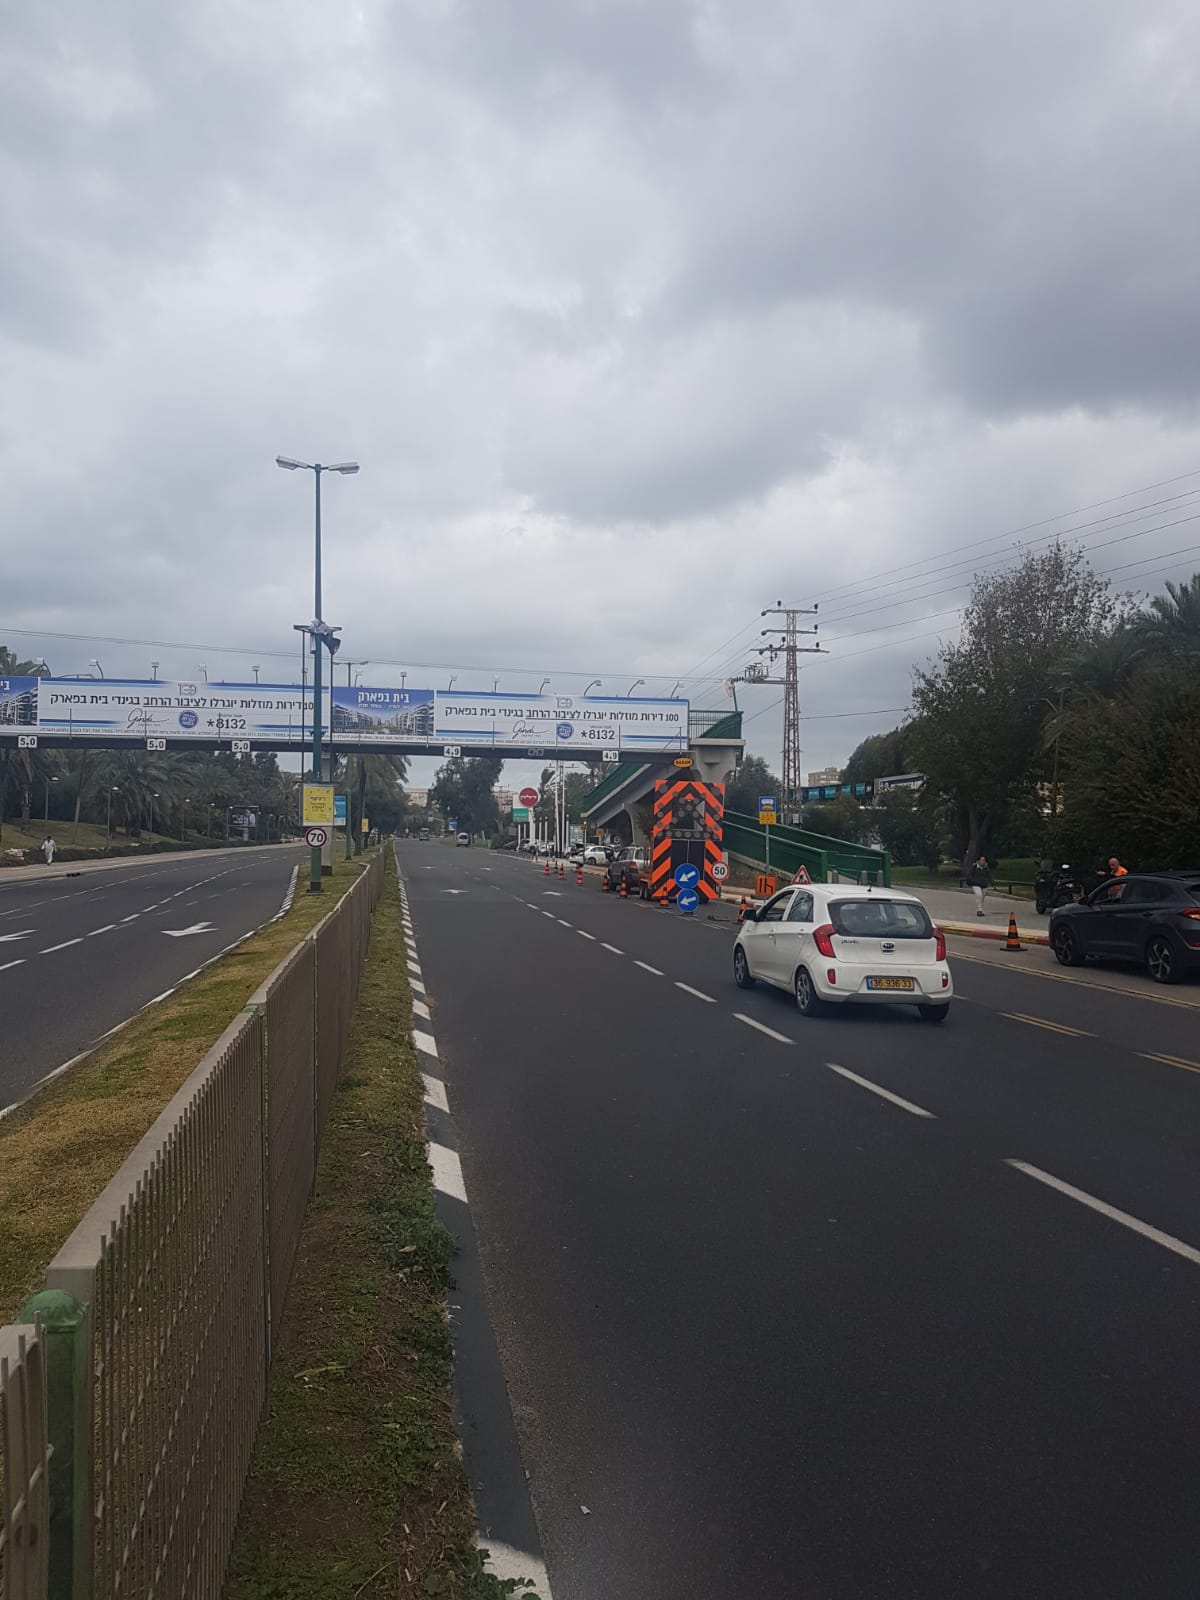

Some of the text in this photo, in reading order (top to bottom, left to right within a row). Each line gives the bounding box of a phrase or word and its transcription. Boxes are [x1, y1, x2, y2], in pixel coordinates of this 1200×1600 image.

[0, 680, 10, 691] בי
[50, 693, 87, 705] בפארק
[90, 695, 108, 705] בית
[112, 696, 140, 706] בגינדי
[143, 696, 172, 706] הרחב
[175, 697, 207, 707] לציבור
[357, 691, 410, 703] בית בפארק
[210, 699, 237, 709] יוגרלו
[240, 699, 273, 709] מוזלות
[275, 700, 302, 710] דירות
[445, 706, 679, 722] 100 דירות מוזלות יוגרלו לציבור הרחב בגינדי בית בפארק
[20, 737, 36, 746] 5.0
[149, 740, 165, 749] 5.0
[233, 741, 249, 750] 5.0
[445, 747, 460, 756] 4.9
[603, 752, 618, 761] 4.9
[310, 833, 324, 843] 70
[713, 866, 726, 876] 50
